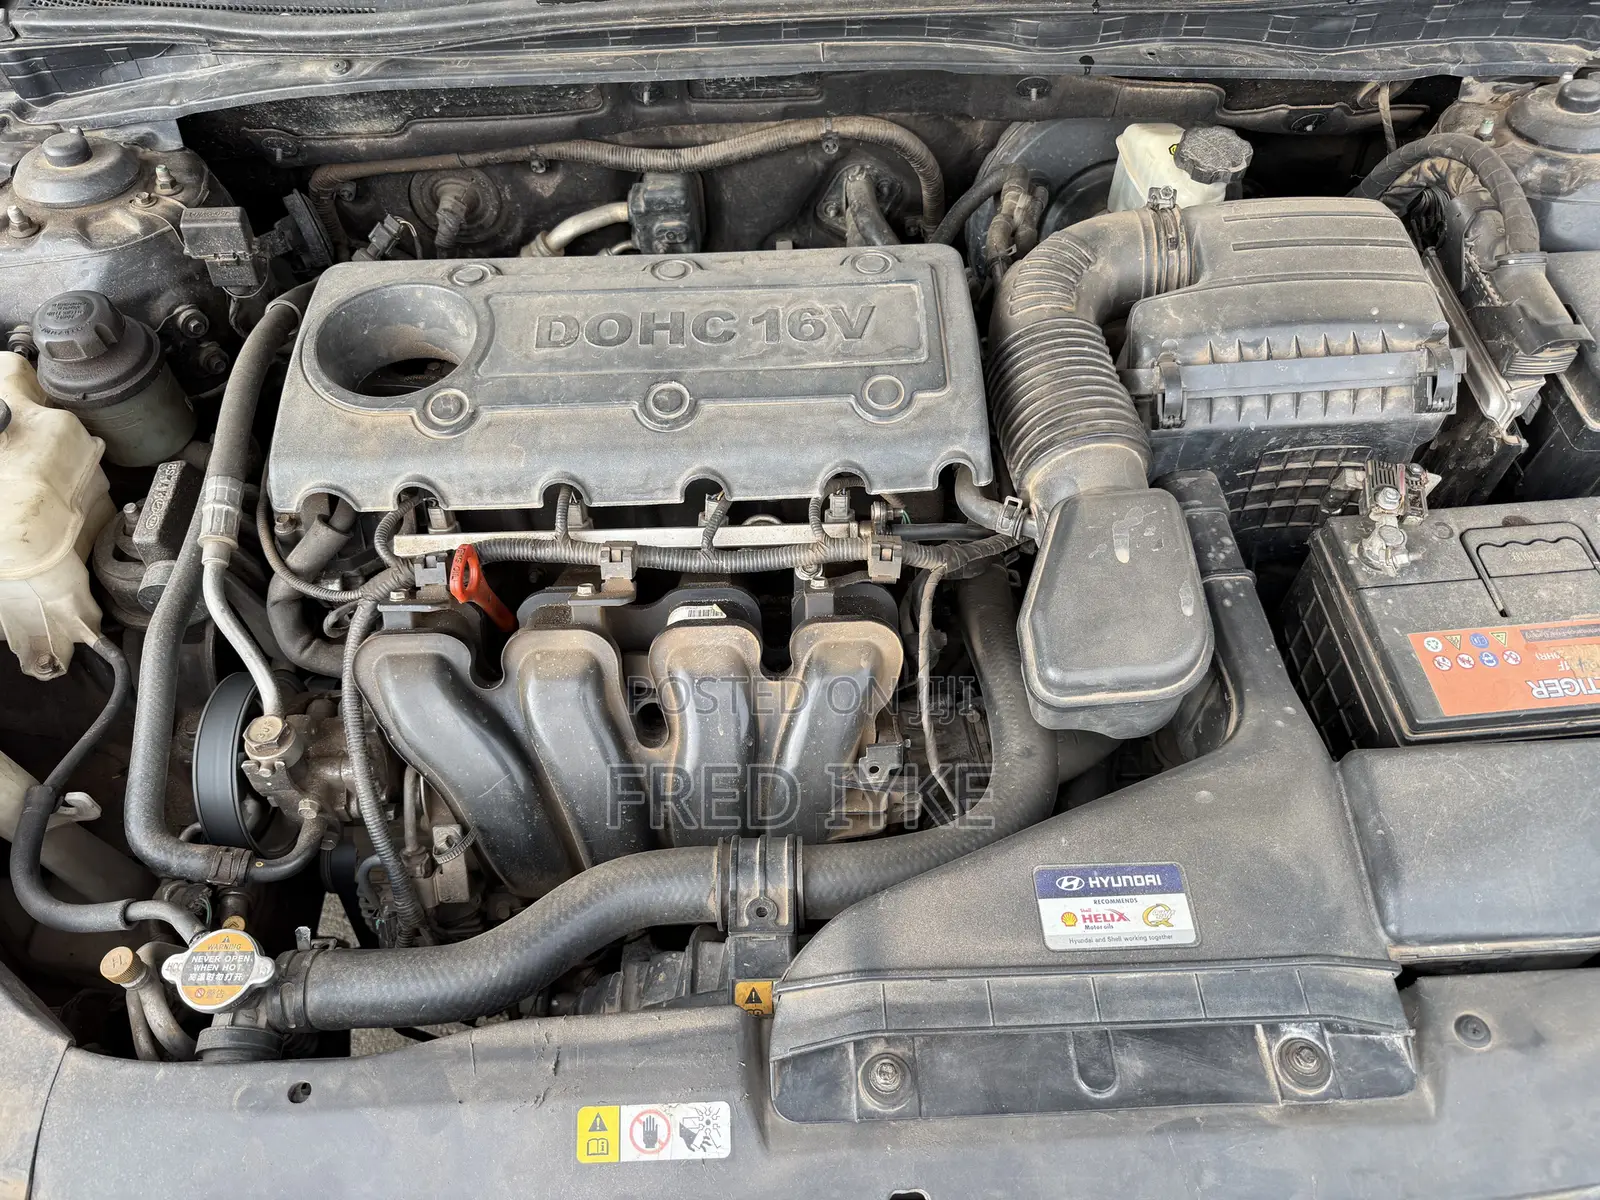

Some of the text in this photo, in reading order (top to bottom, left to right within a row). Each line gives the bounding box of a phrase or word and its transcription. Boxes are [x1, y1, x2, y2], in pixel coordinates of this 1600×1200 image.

[534, 303, 876, 350] DOHC 16V
[1525, 676, 1600, 699] TIGER
[1088, 874, 1162, 888] HYUNDAI
[1093, 897, 1138, 905] RECOMMENDS
[1081, 911, 1129, 924] HELIX
[1069, 934, 1173, 945] Hyundai and Shell working together
[207, 943, 242, 951] WARNING
[191, 955, 220, 963] NEVER
[193, 963, 242, 972] WHEN HOT
